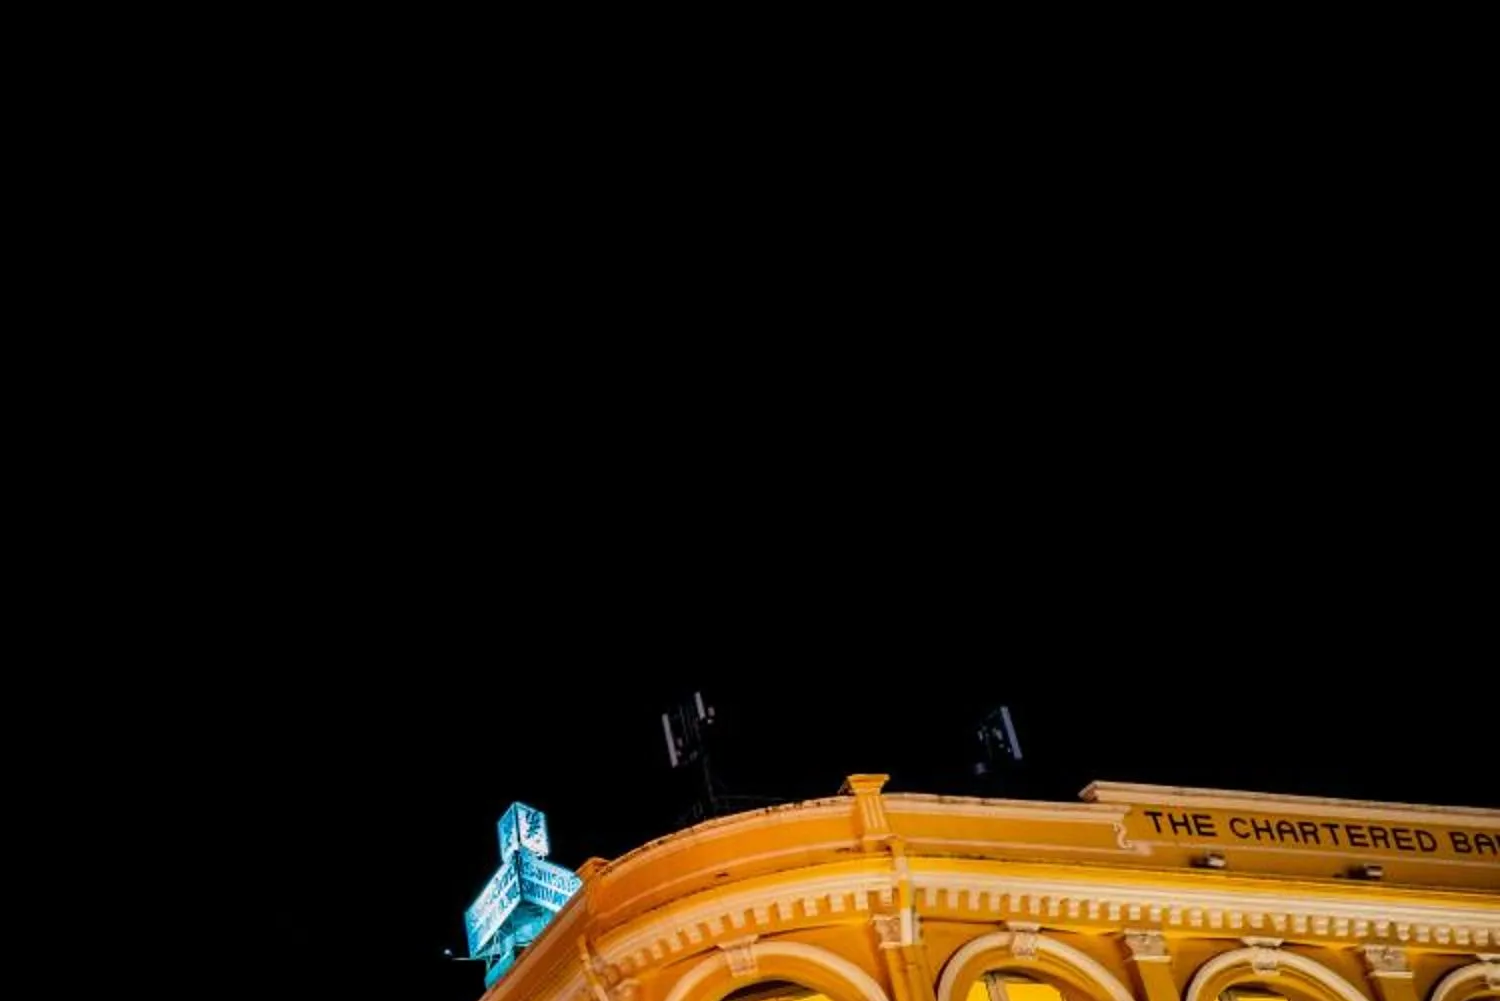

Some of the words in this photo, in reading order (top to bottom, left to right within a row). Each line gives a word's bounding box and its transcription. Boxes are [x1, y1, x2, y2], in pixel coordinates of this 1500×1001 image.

[1144, 811, 1219, 838] THE
[1229, 817, 1438, 853] CHARTERED
[1447, 831, 1500, 857] BA
